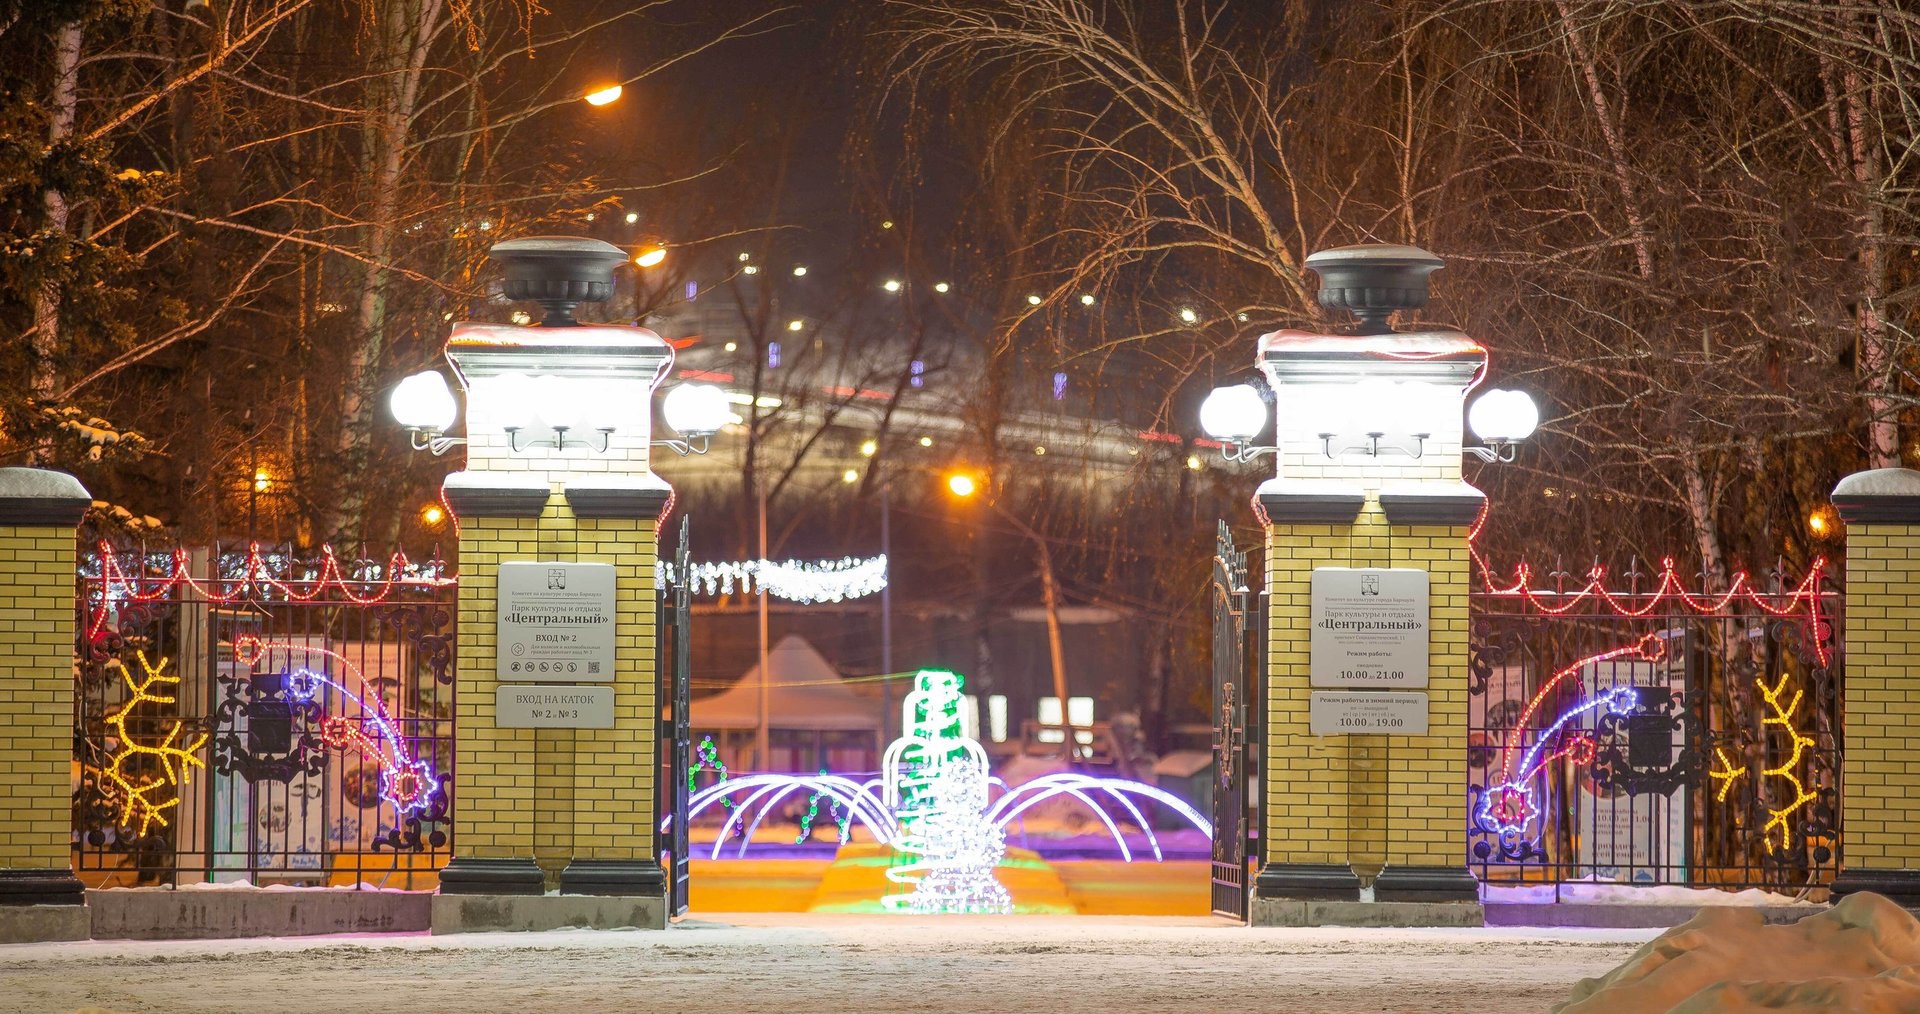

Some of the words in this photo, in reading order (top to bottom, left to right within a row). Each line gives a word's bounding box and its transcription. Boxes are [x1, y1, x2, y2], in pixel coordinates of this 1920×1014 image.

[504, 613, 608, 625] «Центральный»
[1318, 618, 1422, 631] «Центральный»
[1341, 671, 1368, 679] 10.00
[1376, 671, 1404, 680] 21.00
[516, 695, 542, 705] ВХОД
[544, 695, 558, 704] НА
[561, 695, 594, 704] КАТОК
[532, 709, 542, 718] №
[546, 710, 551, 718] 2
[558, 710, 569, 718] №
[572, 710, 578, 718] 3
[1340, 718, 1367, 726] 10.00
[1376, 719, 1403, 727] 19.00
